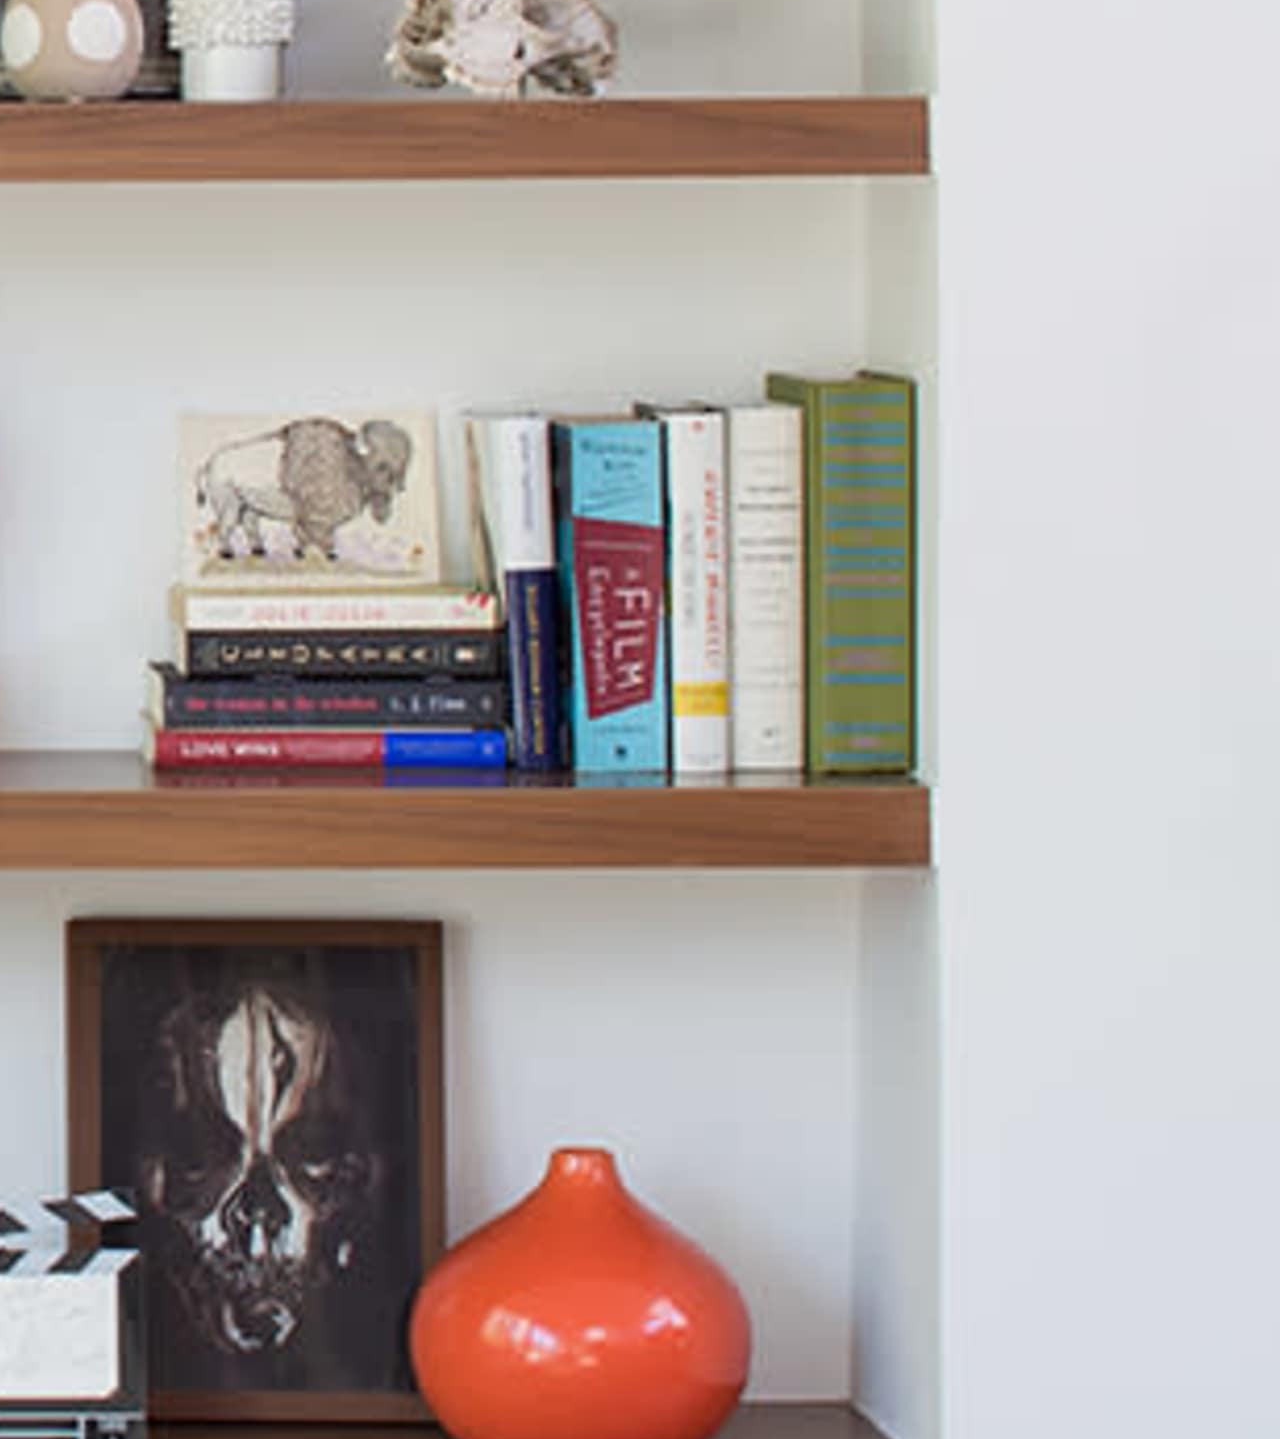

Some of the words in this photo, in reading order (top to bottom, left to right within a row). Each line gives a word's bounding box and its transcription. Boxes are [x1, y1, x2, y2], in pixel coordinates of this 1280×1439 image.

[612, 586, 652, 690] FILM
[220, 642, 431, 666] CLEOPATRA
[180, 740, 228, 758] LOVE
[233, 740, 280, 757] WINS
